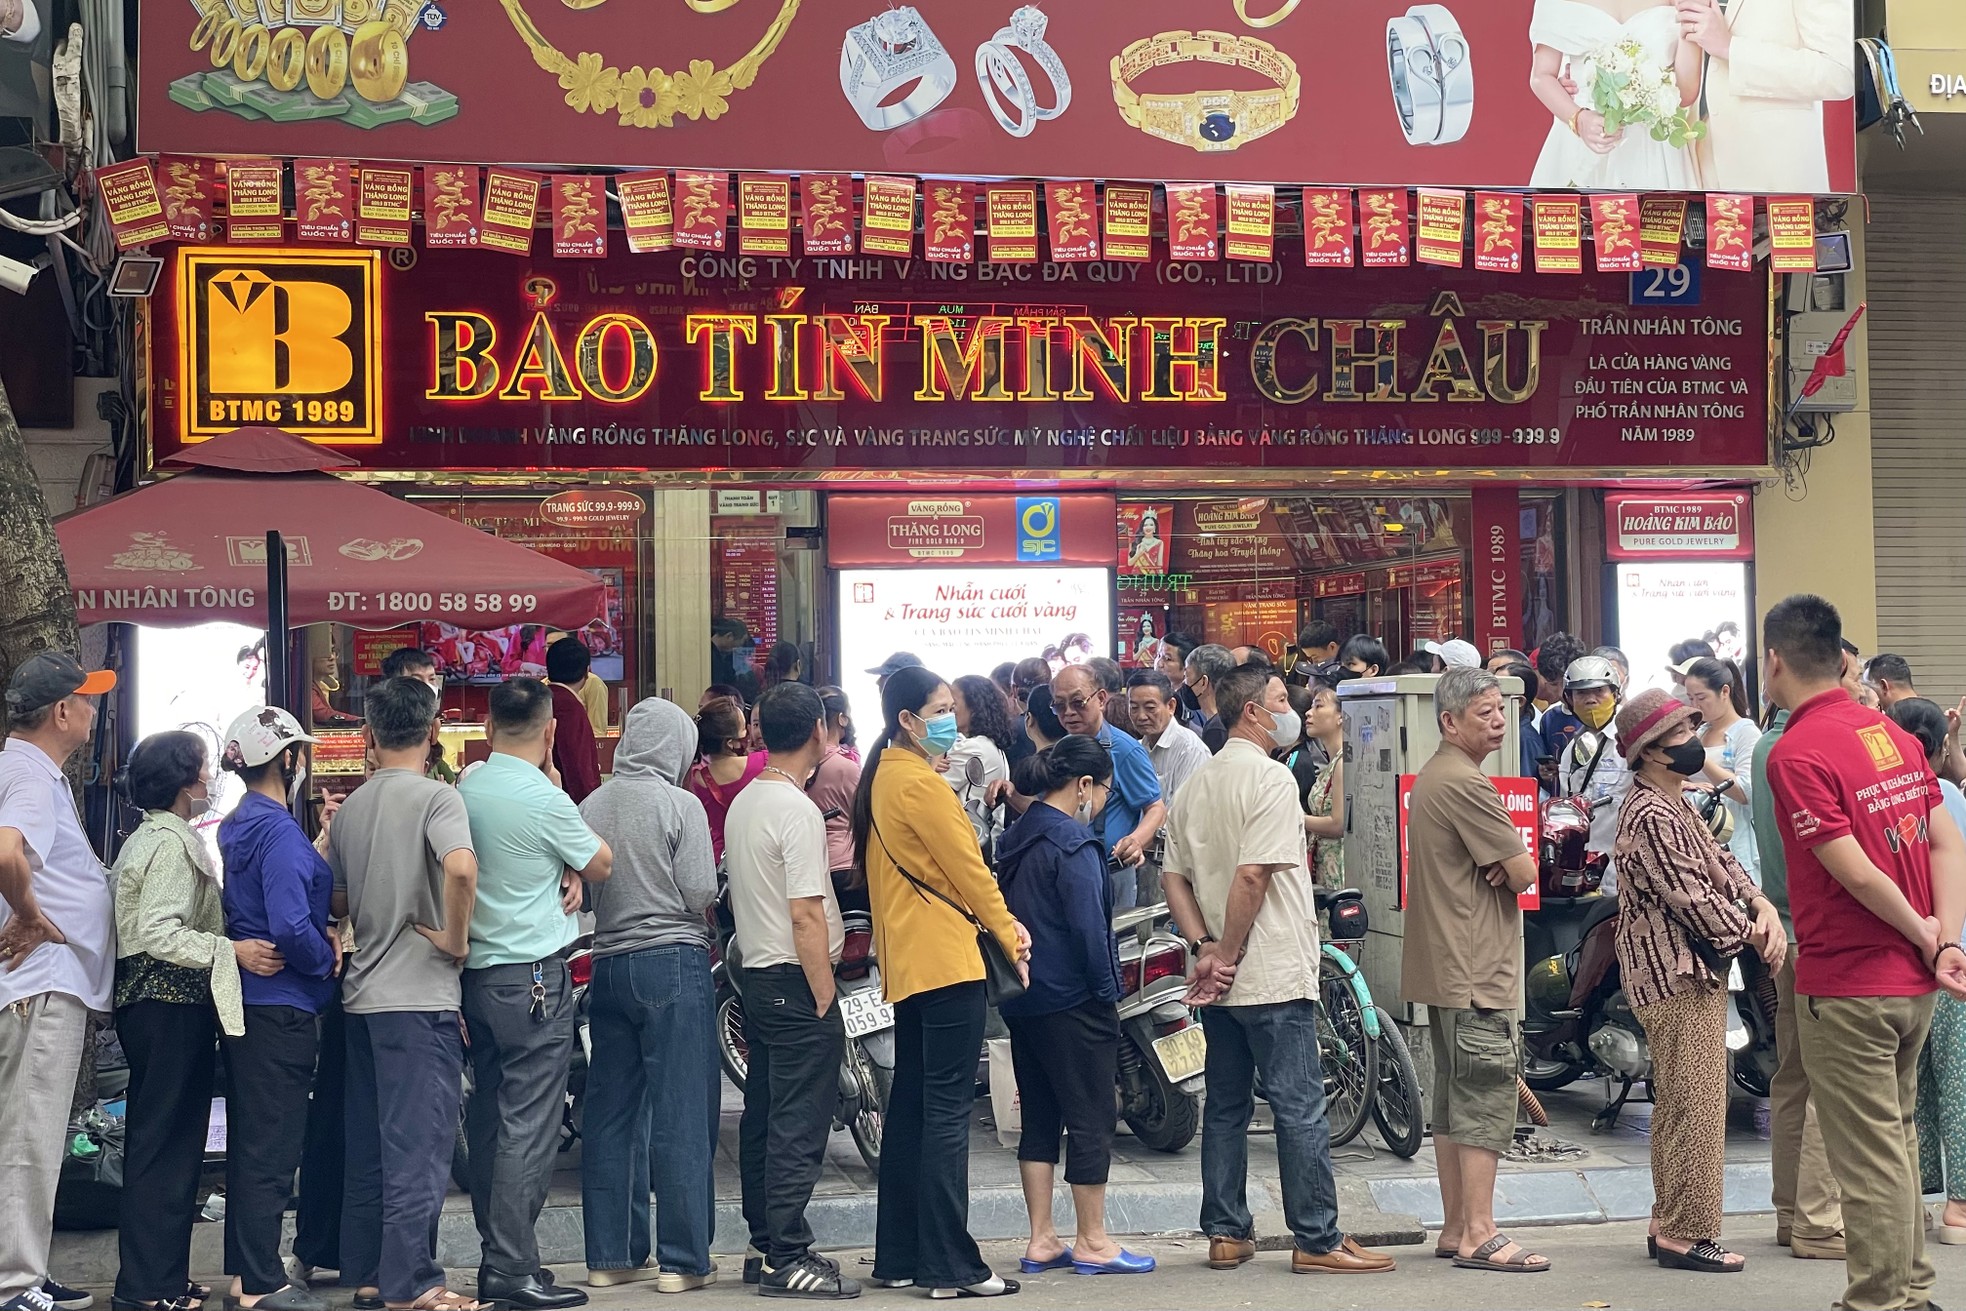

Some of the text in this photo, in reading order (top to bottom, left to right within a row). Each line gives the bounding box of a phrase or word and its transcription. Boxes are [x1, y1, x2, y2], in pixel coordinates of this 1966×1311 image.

[1930, 73, 1966, 98] ĐỊA
[389, 192, 408, 200] LONG
[768, 202, 786, 210] LONG
[680, 252, 757, 279] CÔNG
[767, 259, 802, 278] TY
[813, 258, 883, 279] TNHH
[978, 261, 1032, 287] BẠC
[1156, 261, 1216, 285] (CO.,
[1226, 261, 1283, 285] LTD)
[1643, 263, 1691, 298] 29
[1579, 314, 1742, 336] TRẦN NHÂN TÔNG
[425, 278, 1547, 404] BẢO TÍN MINH CHÂU
[1589, 352, 1732, 370] LÀ CỬA HÀNG VÀNG
[1574, 376, 1748, 394] ĐẦU TIÊN CỦA BTMC VÀ
[210, 400, 354, 422] BTMC 1989
[1576, 400, 1744, 418] PHỐ TRẦN NHÂN TÔNG
[534, 424, 586, 446] VÀNG
[592, 422, 646, 446] RỒNG
[652, 425, 717, 446] THĂNG
[722, 429, 778, 449] LONG,
[824, 425, 848, 446] VÀ
[854, 426, 904, 446] VÀNG
[909, 429, 970, 446] TRANG
[974, 425, 1010, 446] SỨC
[1014, 426, 1042, 446] MỸ
[1047, 426, 1096, 450] NGHỆ
[1100, 424, 1145, 446] CHẤT
[1152, 426, 1189, 450] LIỆU
[1197, 422, 1244, 446] BẰNG
[1249, 424, 1296, 446] VÀNG
[1354, 425, 1414, 445] THĂNG
[1418, 428, 1466, 445] LONG
[1621, 426, 1695, 442] NĂM 1989
[546, 502, 575, 512] TRANG
[576, 500, 594, 512] SỨC
[911, 502, 935, 512] VÀNG
[1654, 506, 1702, 514] BTMC 1989
[605, 514, 630, 522] JEWELRY
[1624, 512, 1732, 530] HOÀNG KIM BẢO
[890, 522, 981, 536] THĂNG LONG
[1022, 540, 1056, 556] SJC
[1215, 548, 1228, 557] hoa
[1490, 525, 1506, 563] 1989
[104, 585, 180, 609] NHÂN
[184, 585, 255, 609] TÔNG
[936, 581, 1027, 601] Nhẫn cưới
[1491, 569, 1507, 628] BTMC
[327, 592, 537, 614] ĐT: 1800 58 58 99
[902, 604, 951, 622] Trang
[956, 603, 985, 618] sức
[991, 602, 1028, 618] cưới
[1034, 602, 1077, 621] vàng
[1856, 784, 1881, 802] PHỤC
[844, 990, 882, 1016] 29-E
[846, 1005, 894, 1034] 059.9
